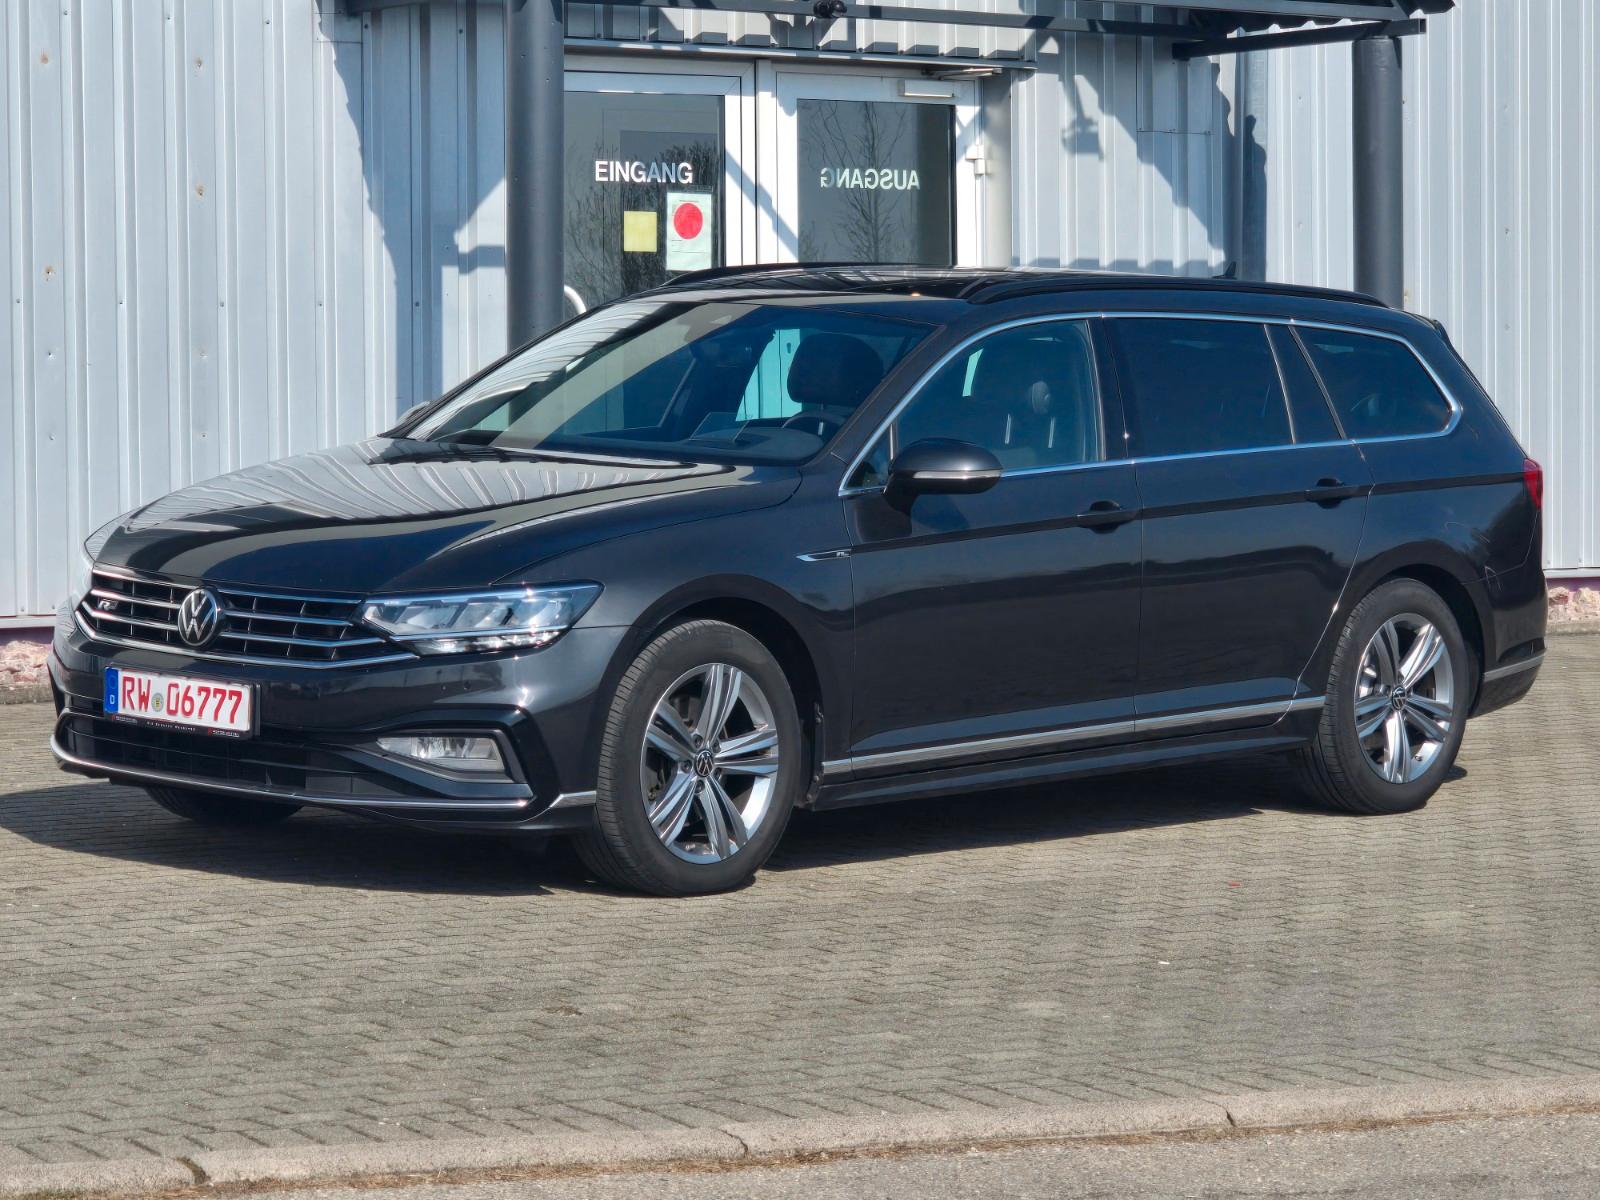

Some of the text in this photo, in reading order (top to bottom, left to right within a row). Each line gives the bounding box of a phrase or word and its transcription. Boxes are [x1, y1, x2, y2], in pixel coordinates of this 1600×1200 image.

[595, 160, 693, 184] EINGANG
[122, 676, 243, 725] RW 06777
